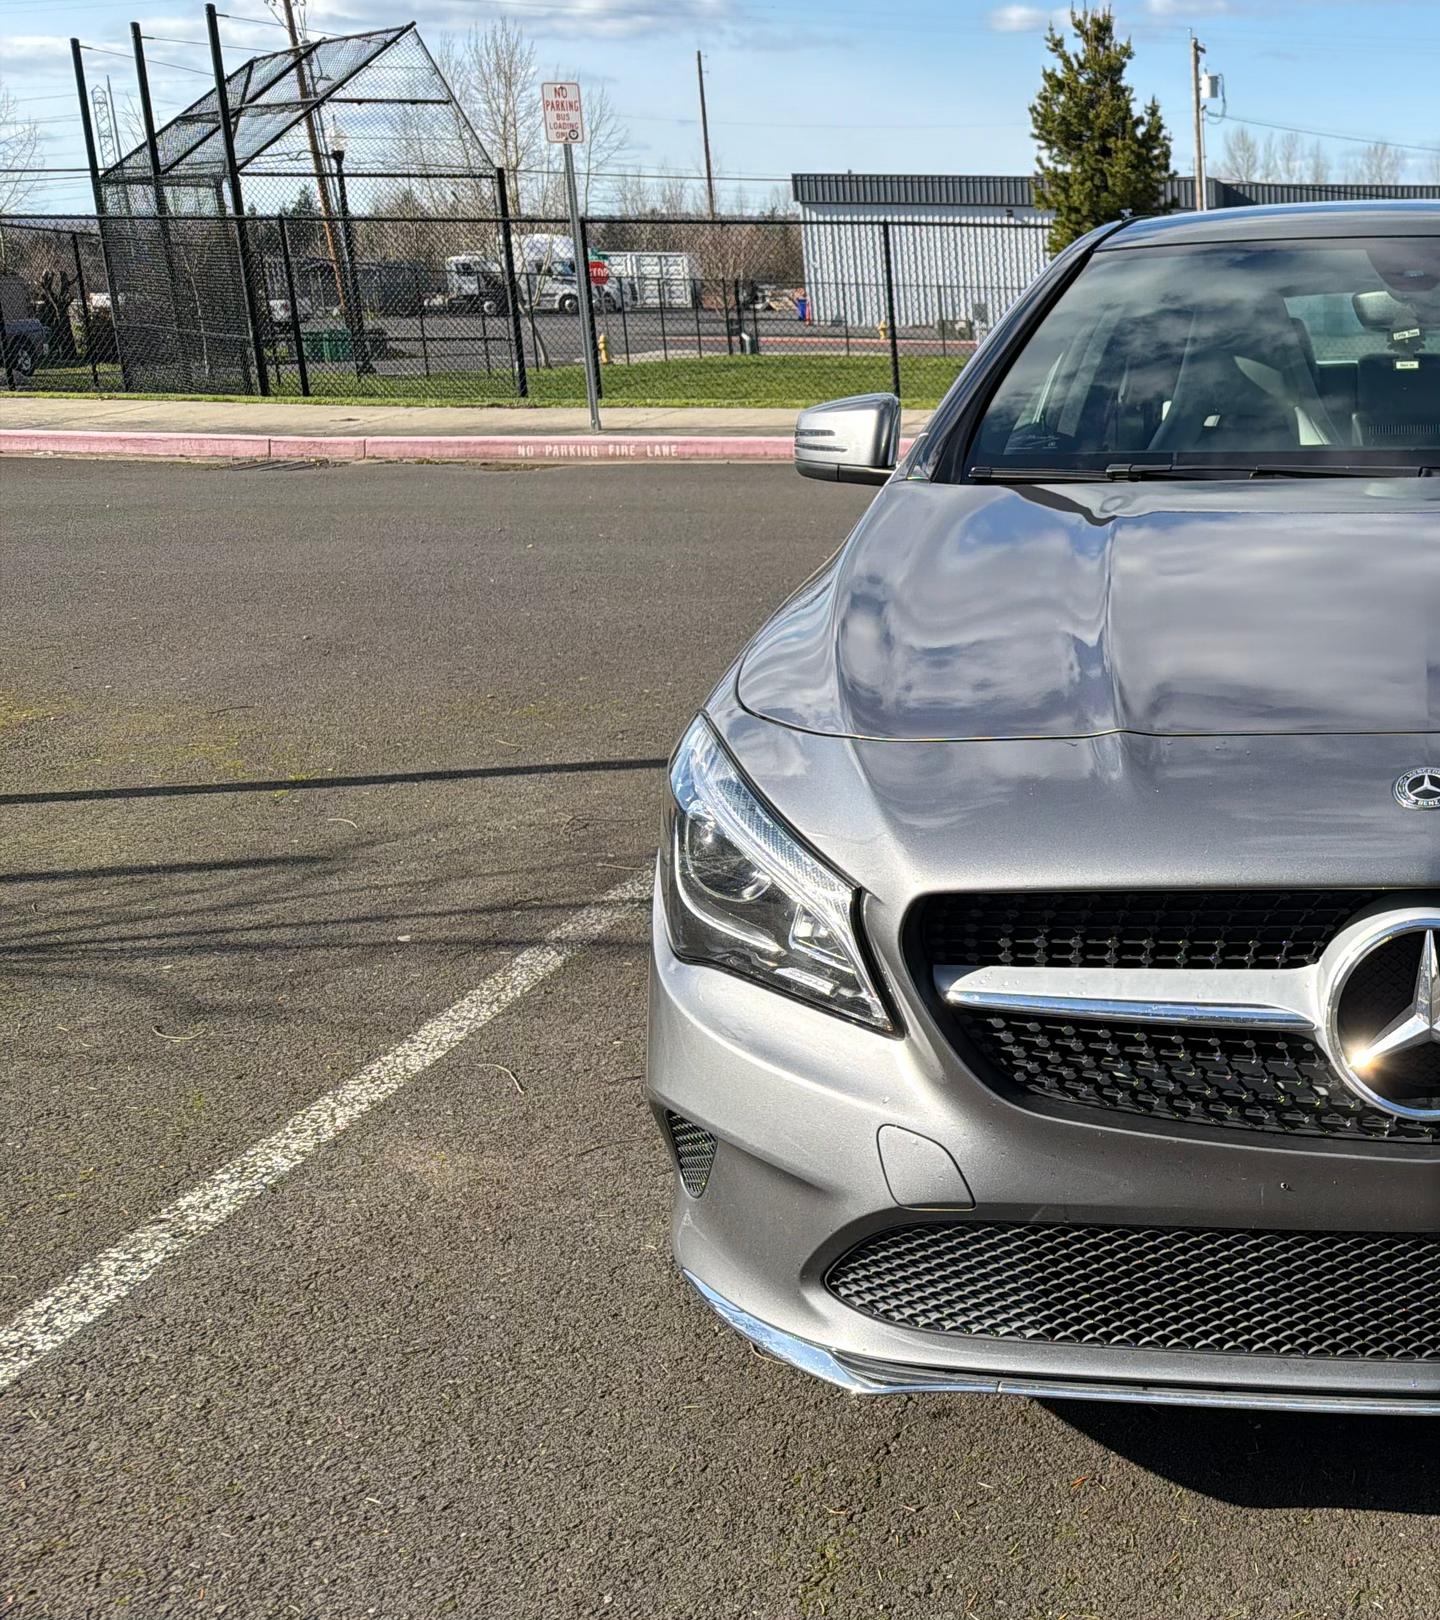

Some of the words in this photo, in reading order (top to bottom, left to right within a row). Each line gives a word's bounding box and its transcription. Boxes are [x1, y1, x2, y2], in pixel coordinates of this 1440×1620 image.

[554, 86, 568, 99] NO
[545, 100, 579, 112] PARKING
[556, 113, 570, 121] BUS
[549, 122, 579, 130] LOADING
[517, 445, 534, 456] NO
[544, 445, 599, 456] PARKING
[608, 444, 636, 456] FIRE
[646, 444, 678, 456] LANE
